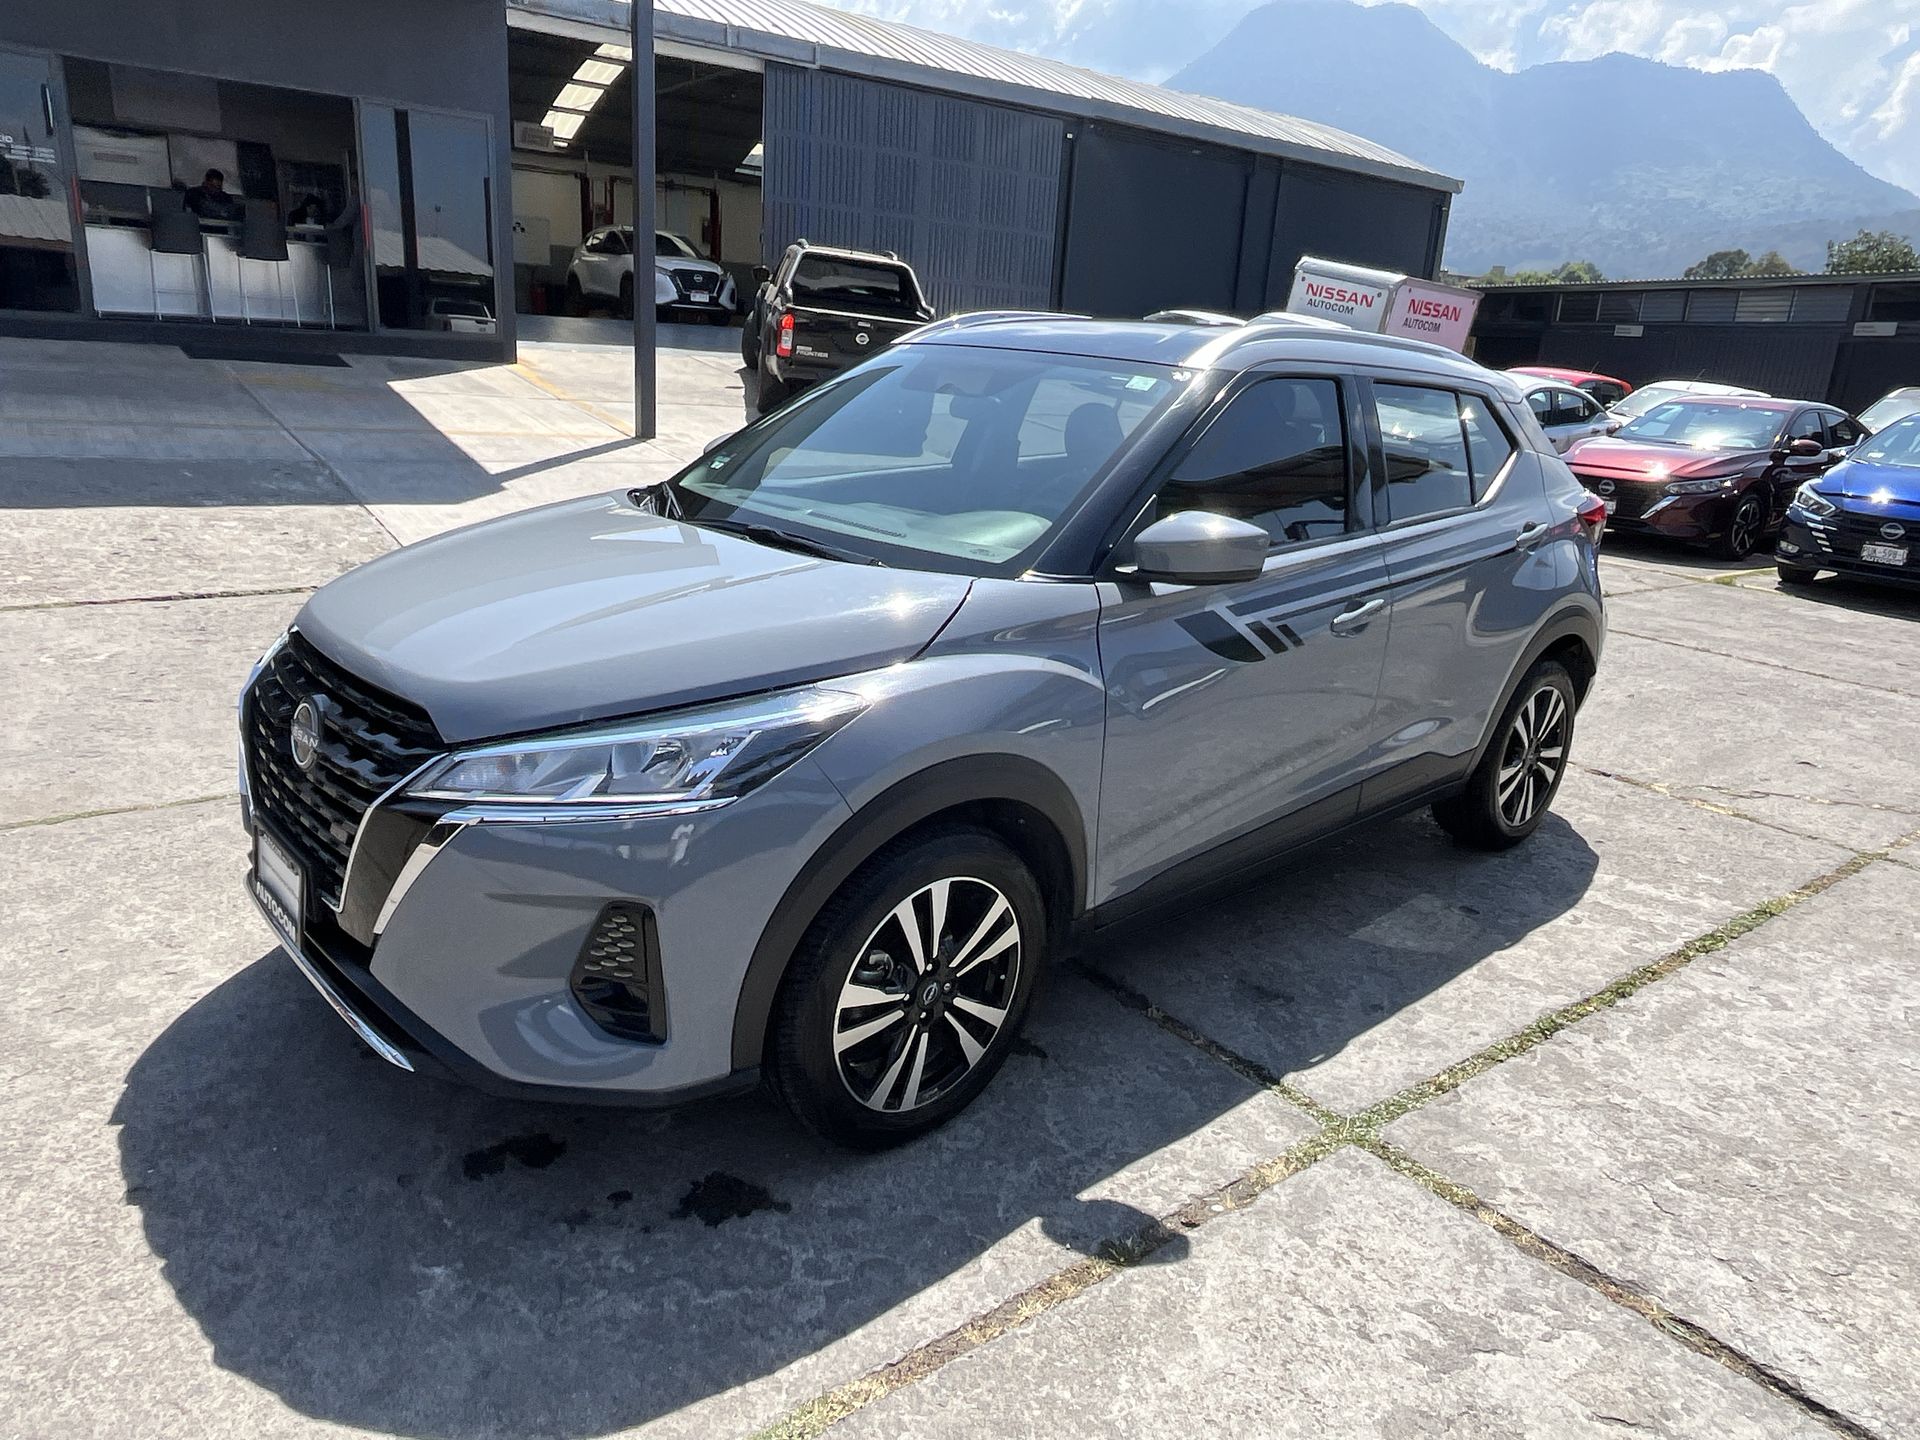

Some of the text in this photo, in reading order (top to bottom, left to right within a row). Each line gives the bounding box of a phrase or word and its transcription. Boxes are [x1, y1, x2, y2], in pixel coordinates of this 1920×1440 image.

[1305, 283, 1375, 308] NISSAN
[1306, 298, 1354, 316] AUTOCOM
[1407, 298, 1462, 322] NISSAN
[1402, 317, 1441, 333] AUTOCOM
[256, 881, 296, 943] AUTOCOM
